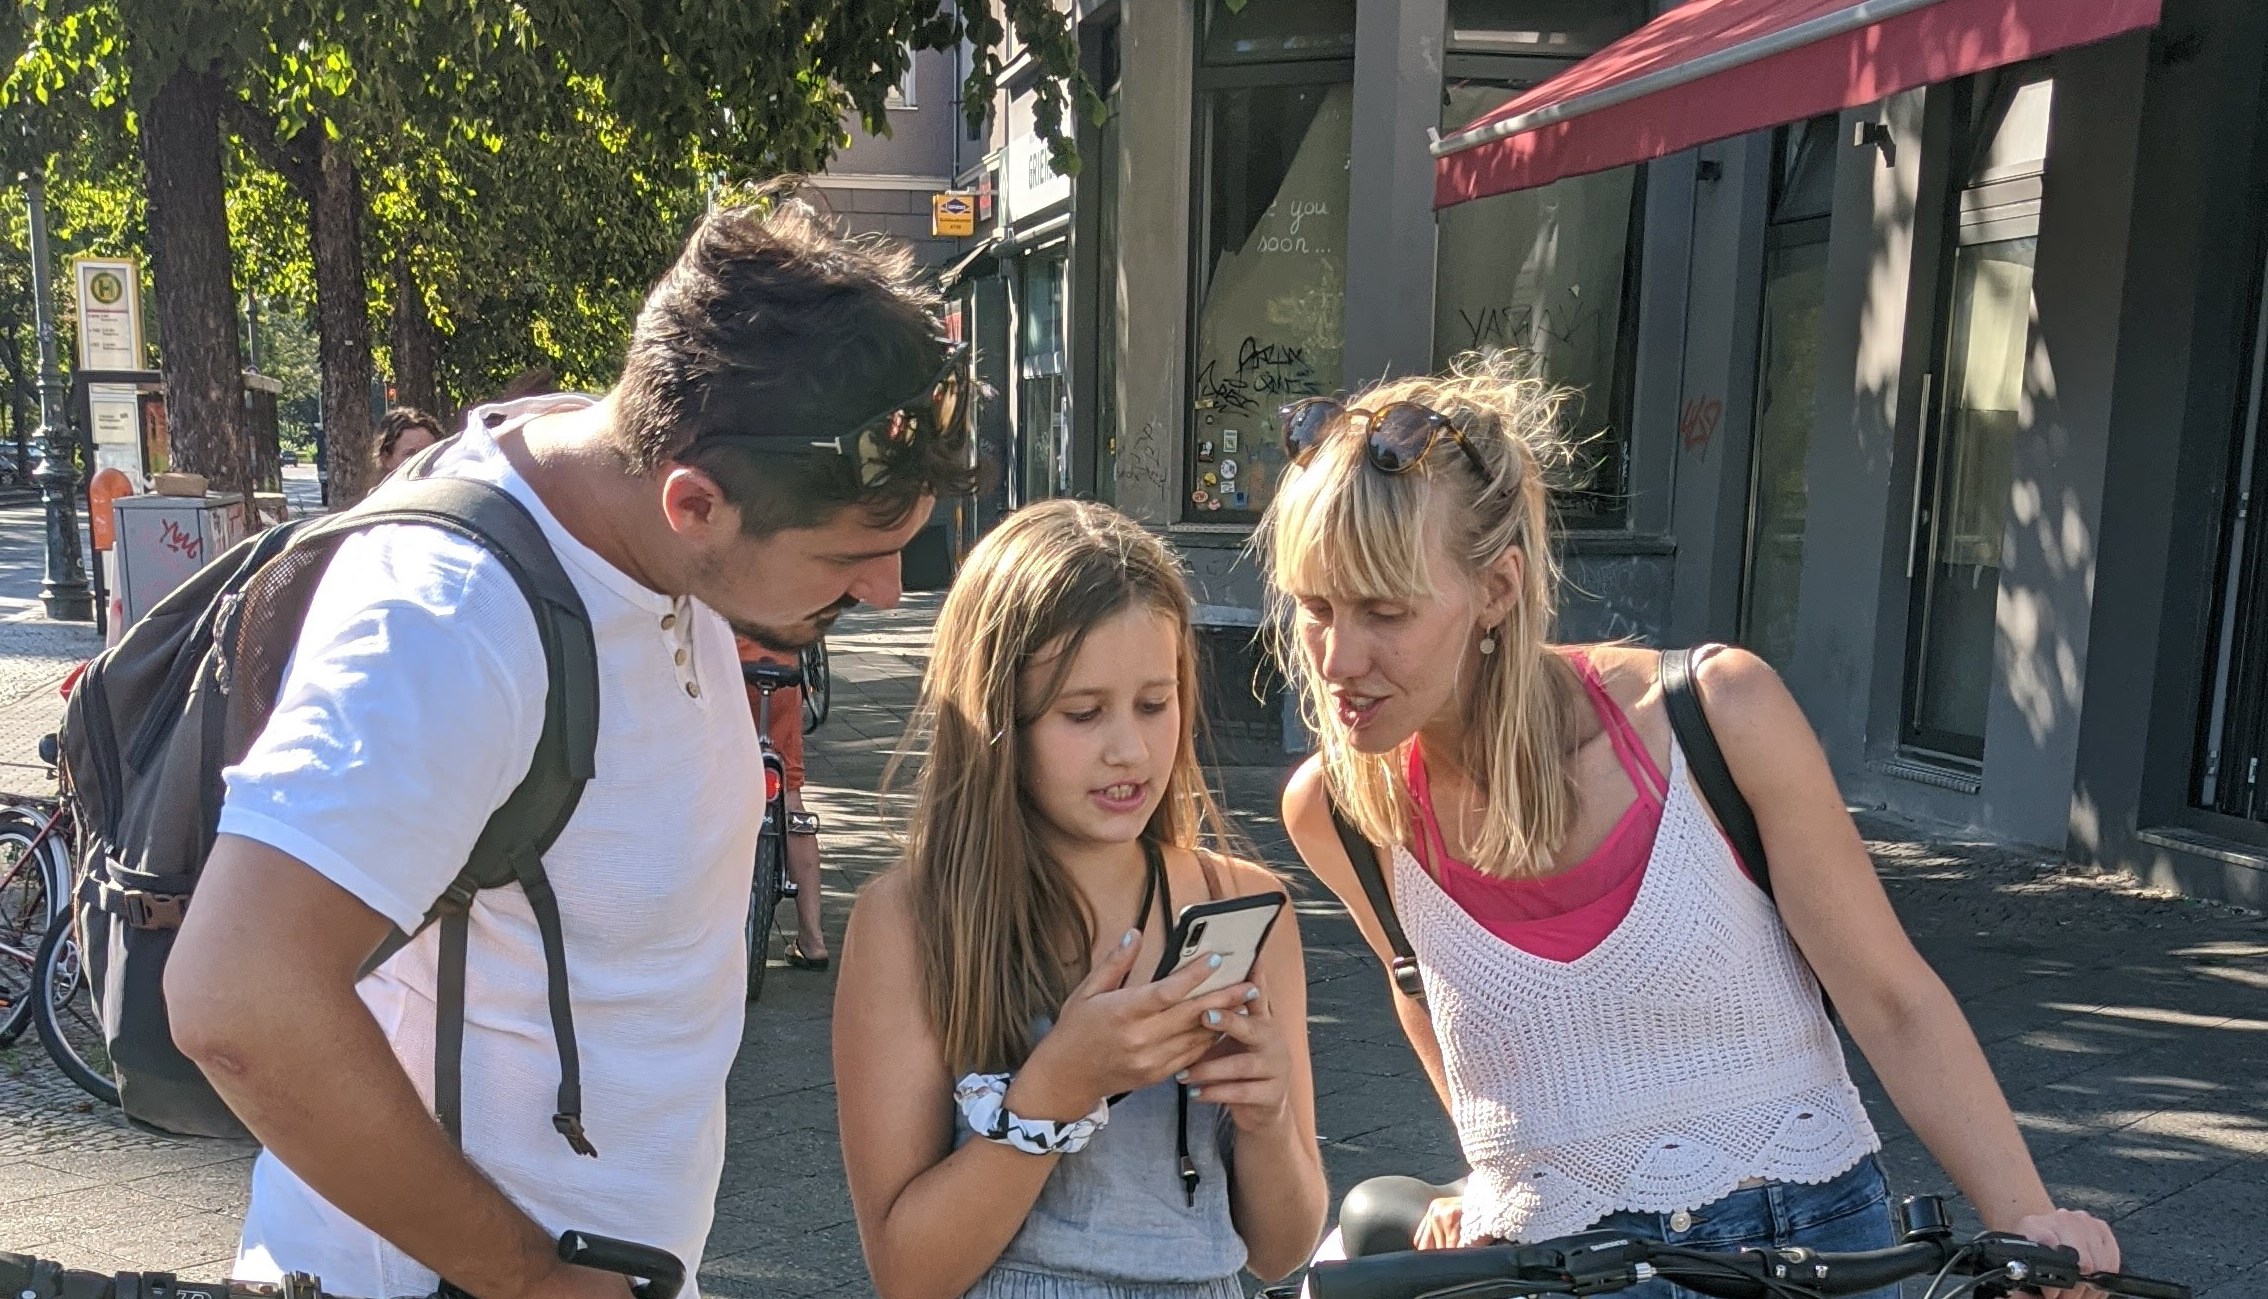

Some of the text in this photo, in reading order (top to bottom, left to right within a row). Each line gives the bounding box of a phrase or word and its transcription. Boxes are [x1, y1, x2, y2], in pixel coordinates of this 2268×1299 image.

[1028, 147, 1053, 190] GRIEN
[1289, 200, 1329, 235] you
[99, 276, 114, 300] H
